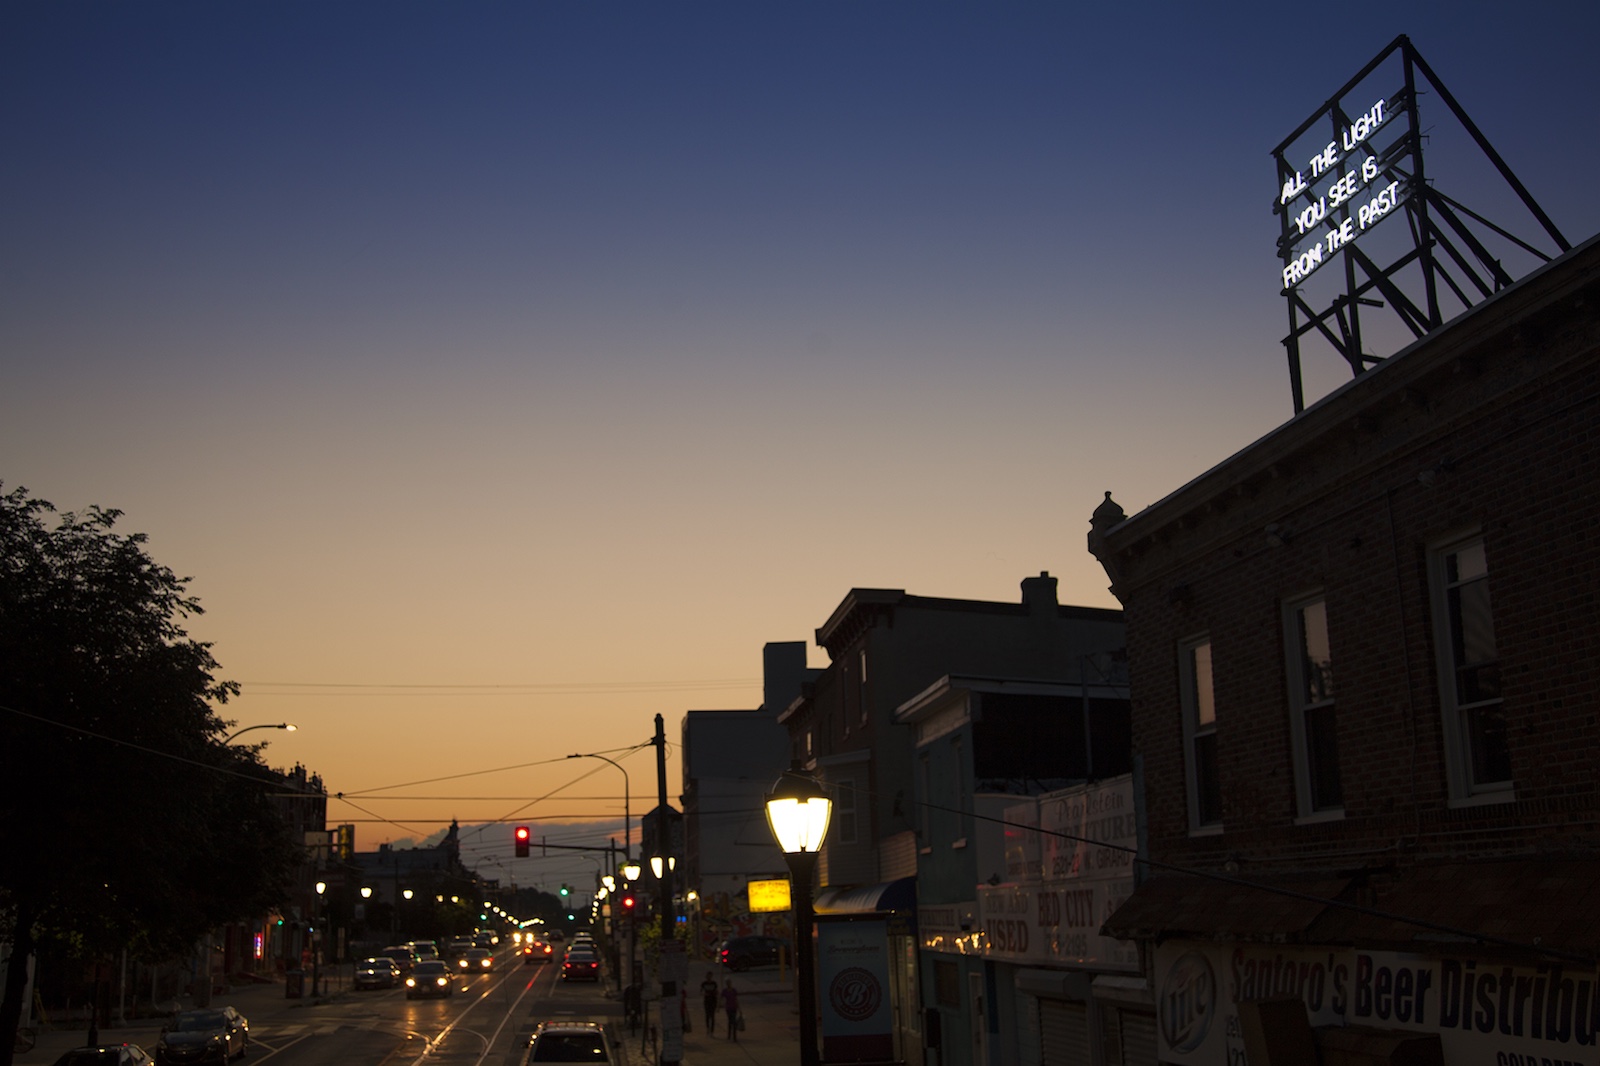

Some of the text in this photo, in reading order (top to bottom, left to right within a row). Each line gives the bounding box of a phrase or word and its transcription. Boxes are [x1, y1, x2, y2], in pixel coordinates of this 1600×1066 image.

[1280, 98, 1385, 204] ALL THE LIGHT
[1295, 155, 1379, 234] YOU SEE IS
[1282, 180, 1399, 289] FROM THE PAST
[986, 918, 1029, 954] USED
[1037, 892, 1061, 927] BED
[1066, 889, 1094, 928] CITY
[1231, 947, 1600, 1046] Santoro's Beer Distribu
